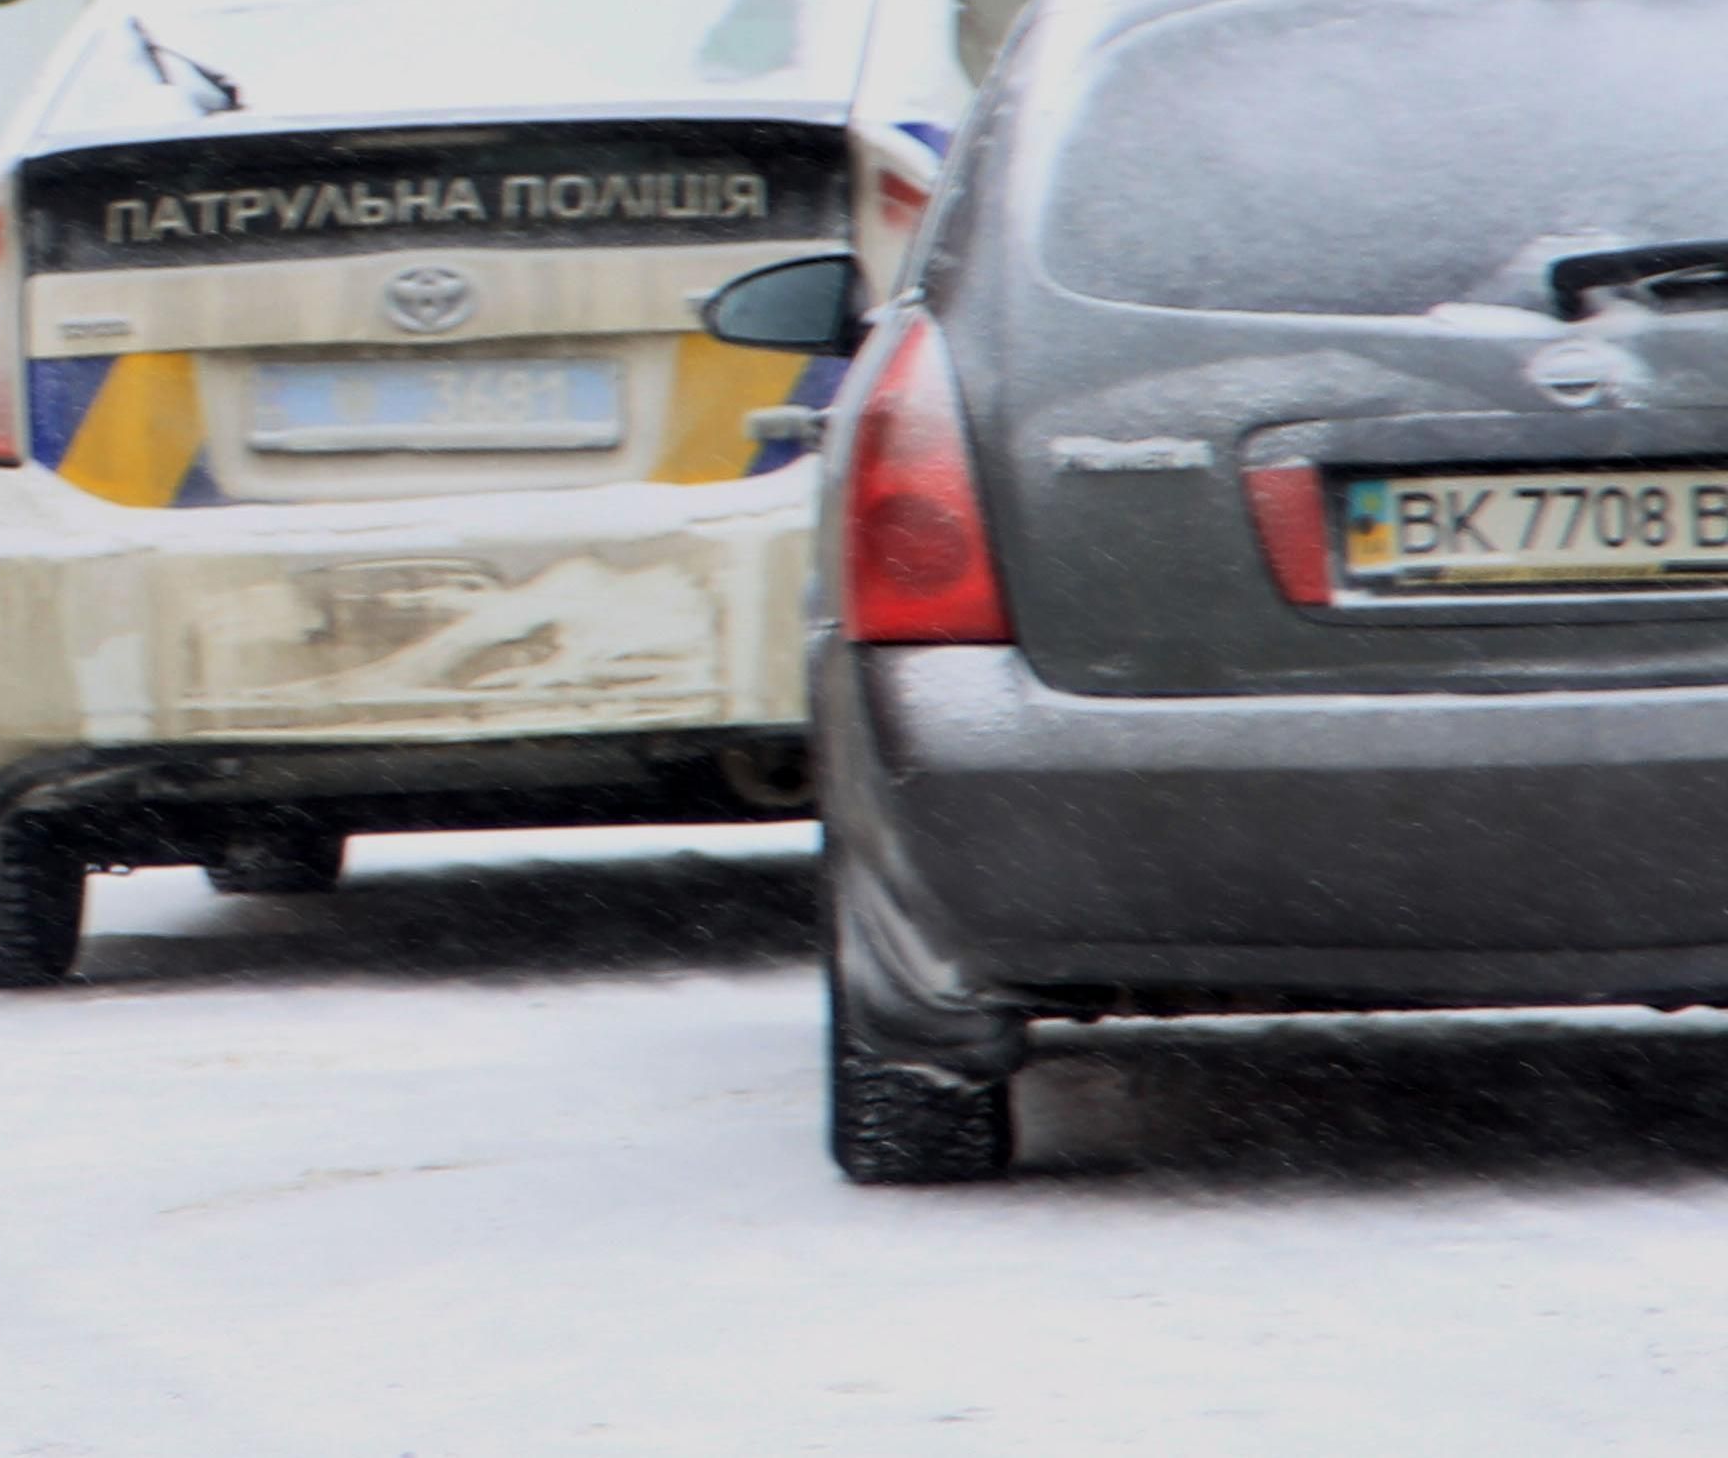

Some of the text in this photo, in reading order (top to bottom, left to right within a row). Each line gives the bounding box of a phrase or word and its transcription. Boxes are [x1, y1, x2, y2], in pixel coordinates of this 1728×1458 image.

[105, 173, 767, 242] ПАТРУЛЬНА ПОЛІЦІЯ
[1512, 486, 1674, 548] 7708
